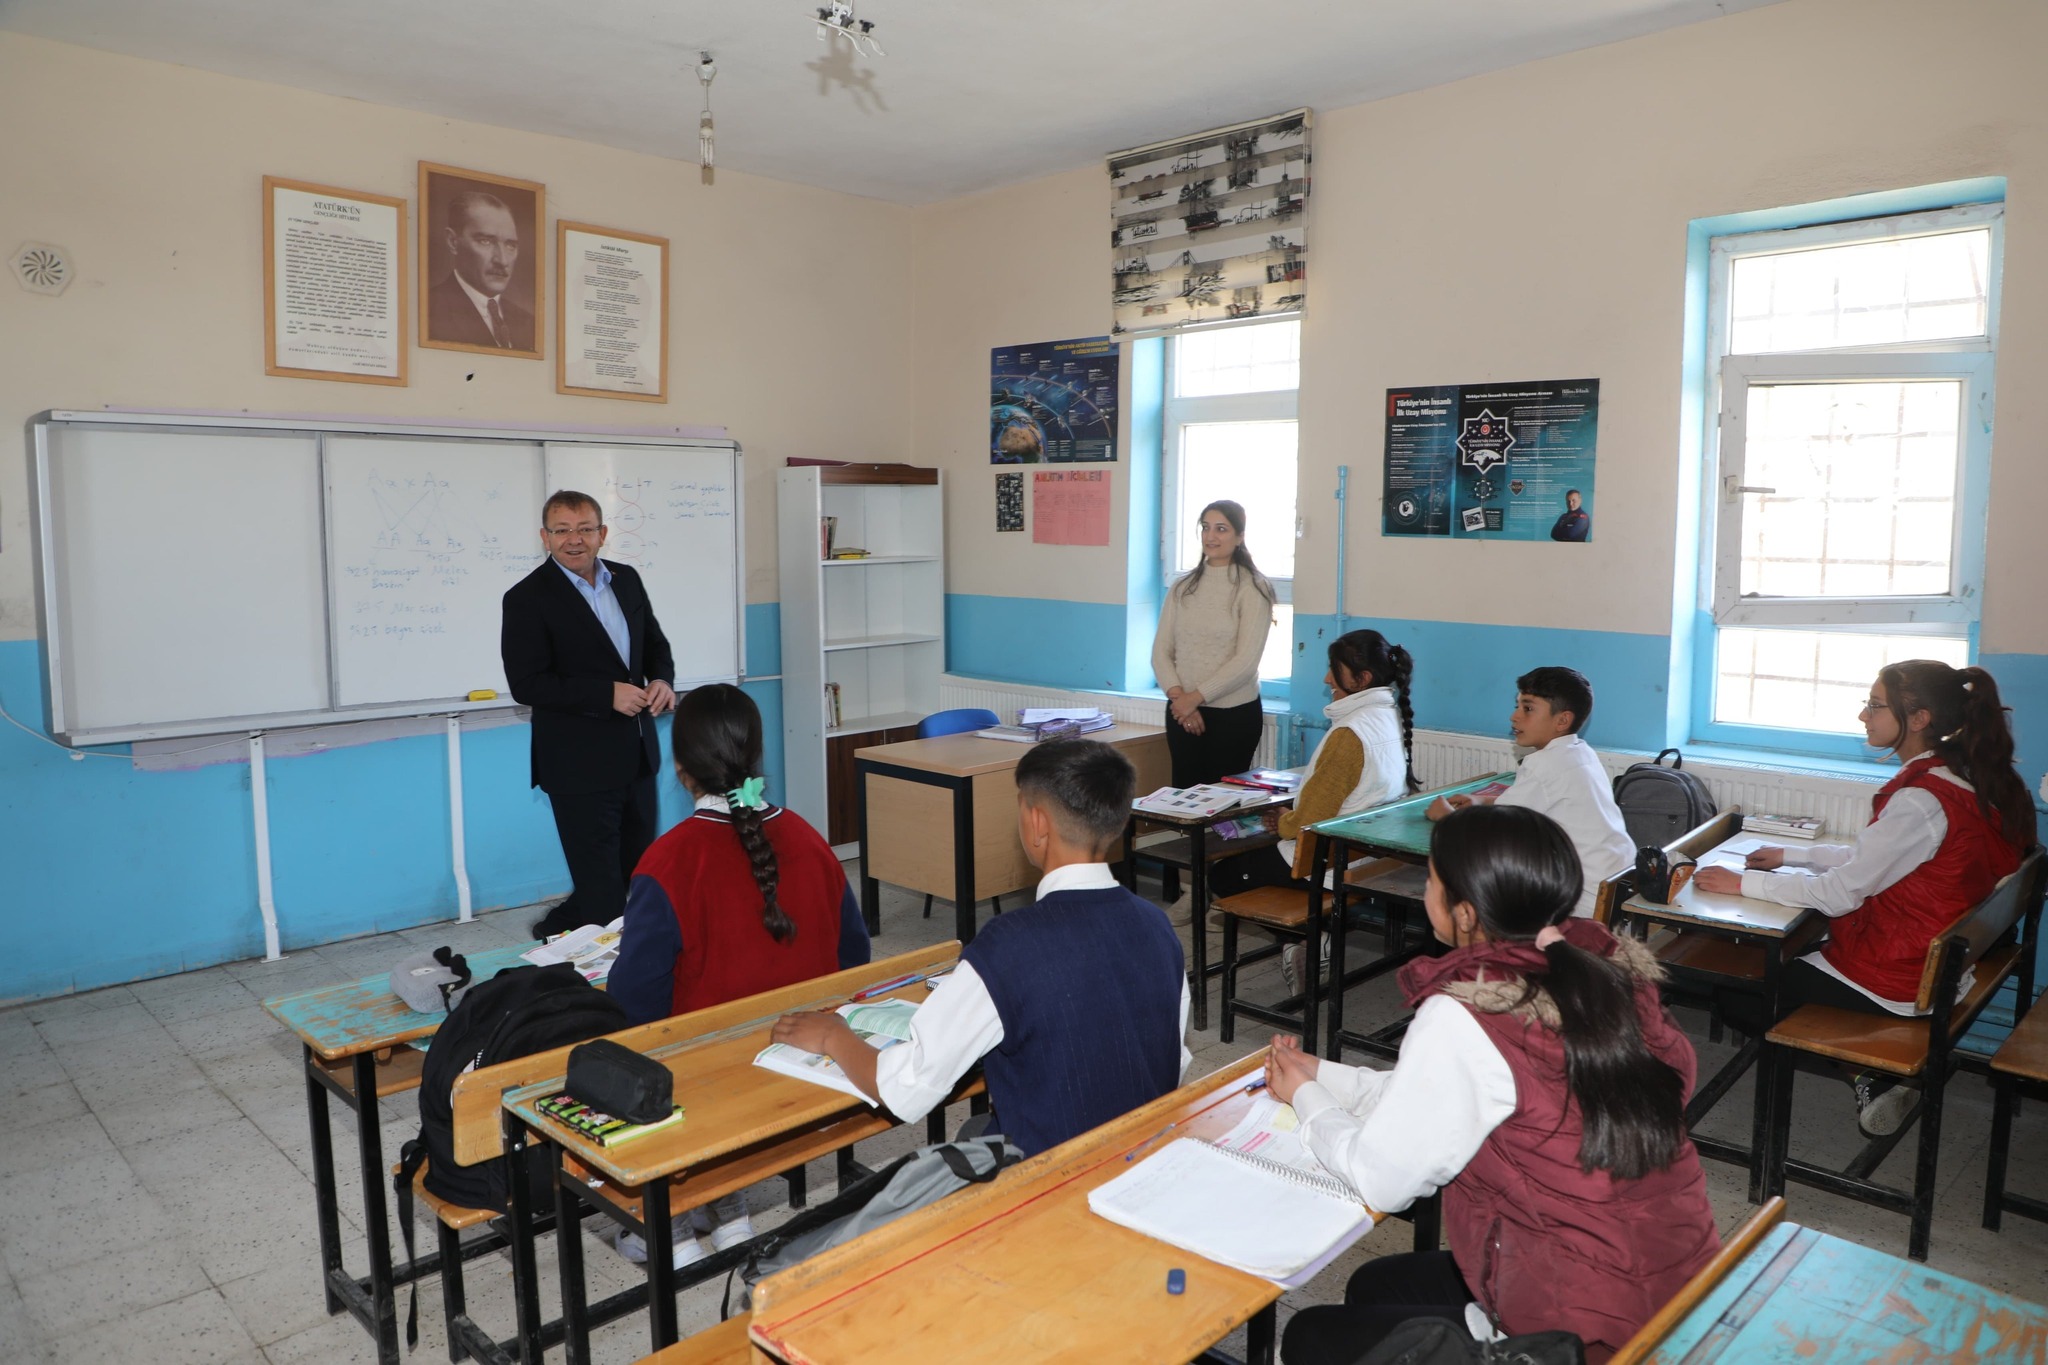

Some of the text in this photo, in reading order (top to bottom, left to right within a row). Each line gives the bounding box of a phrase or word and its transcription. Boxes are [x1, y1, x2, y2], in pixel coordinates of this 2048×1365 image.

[313, 201, 361, 215] ATATÜRK'ÜN
[1396, 397, 1453, 408] Türkiye'nin İnsanlı
[1396, 407, 1447, 418] İlk Uzay Misyonu
